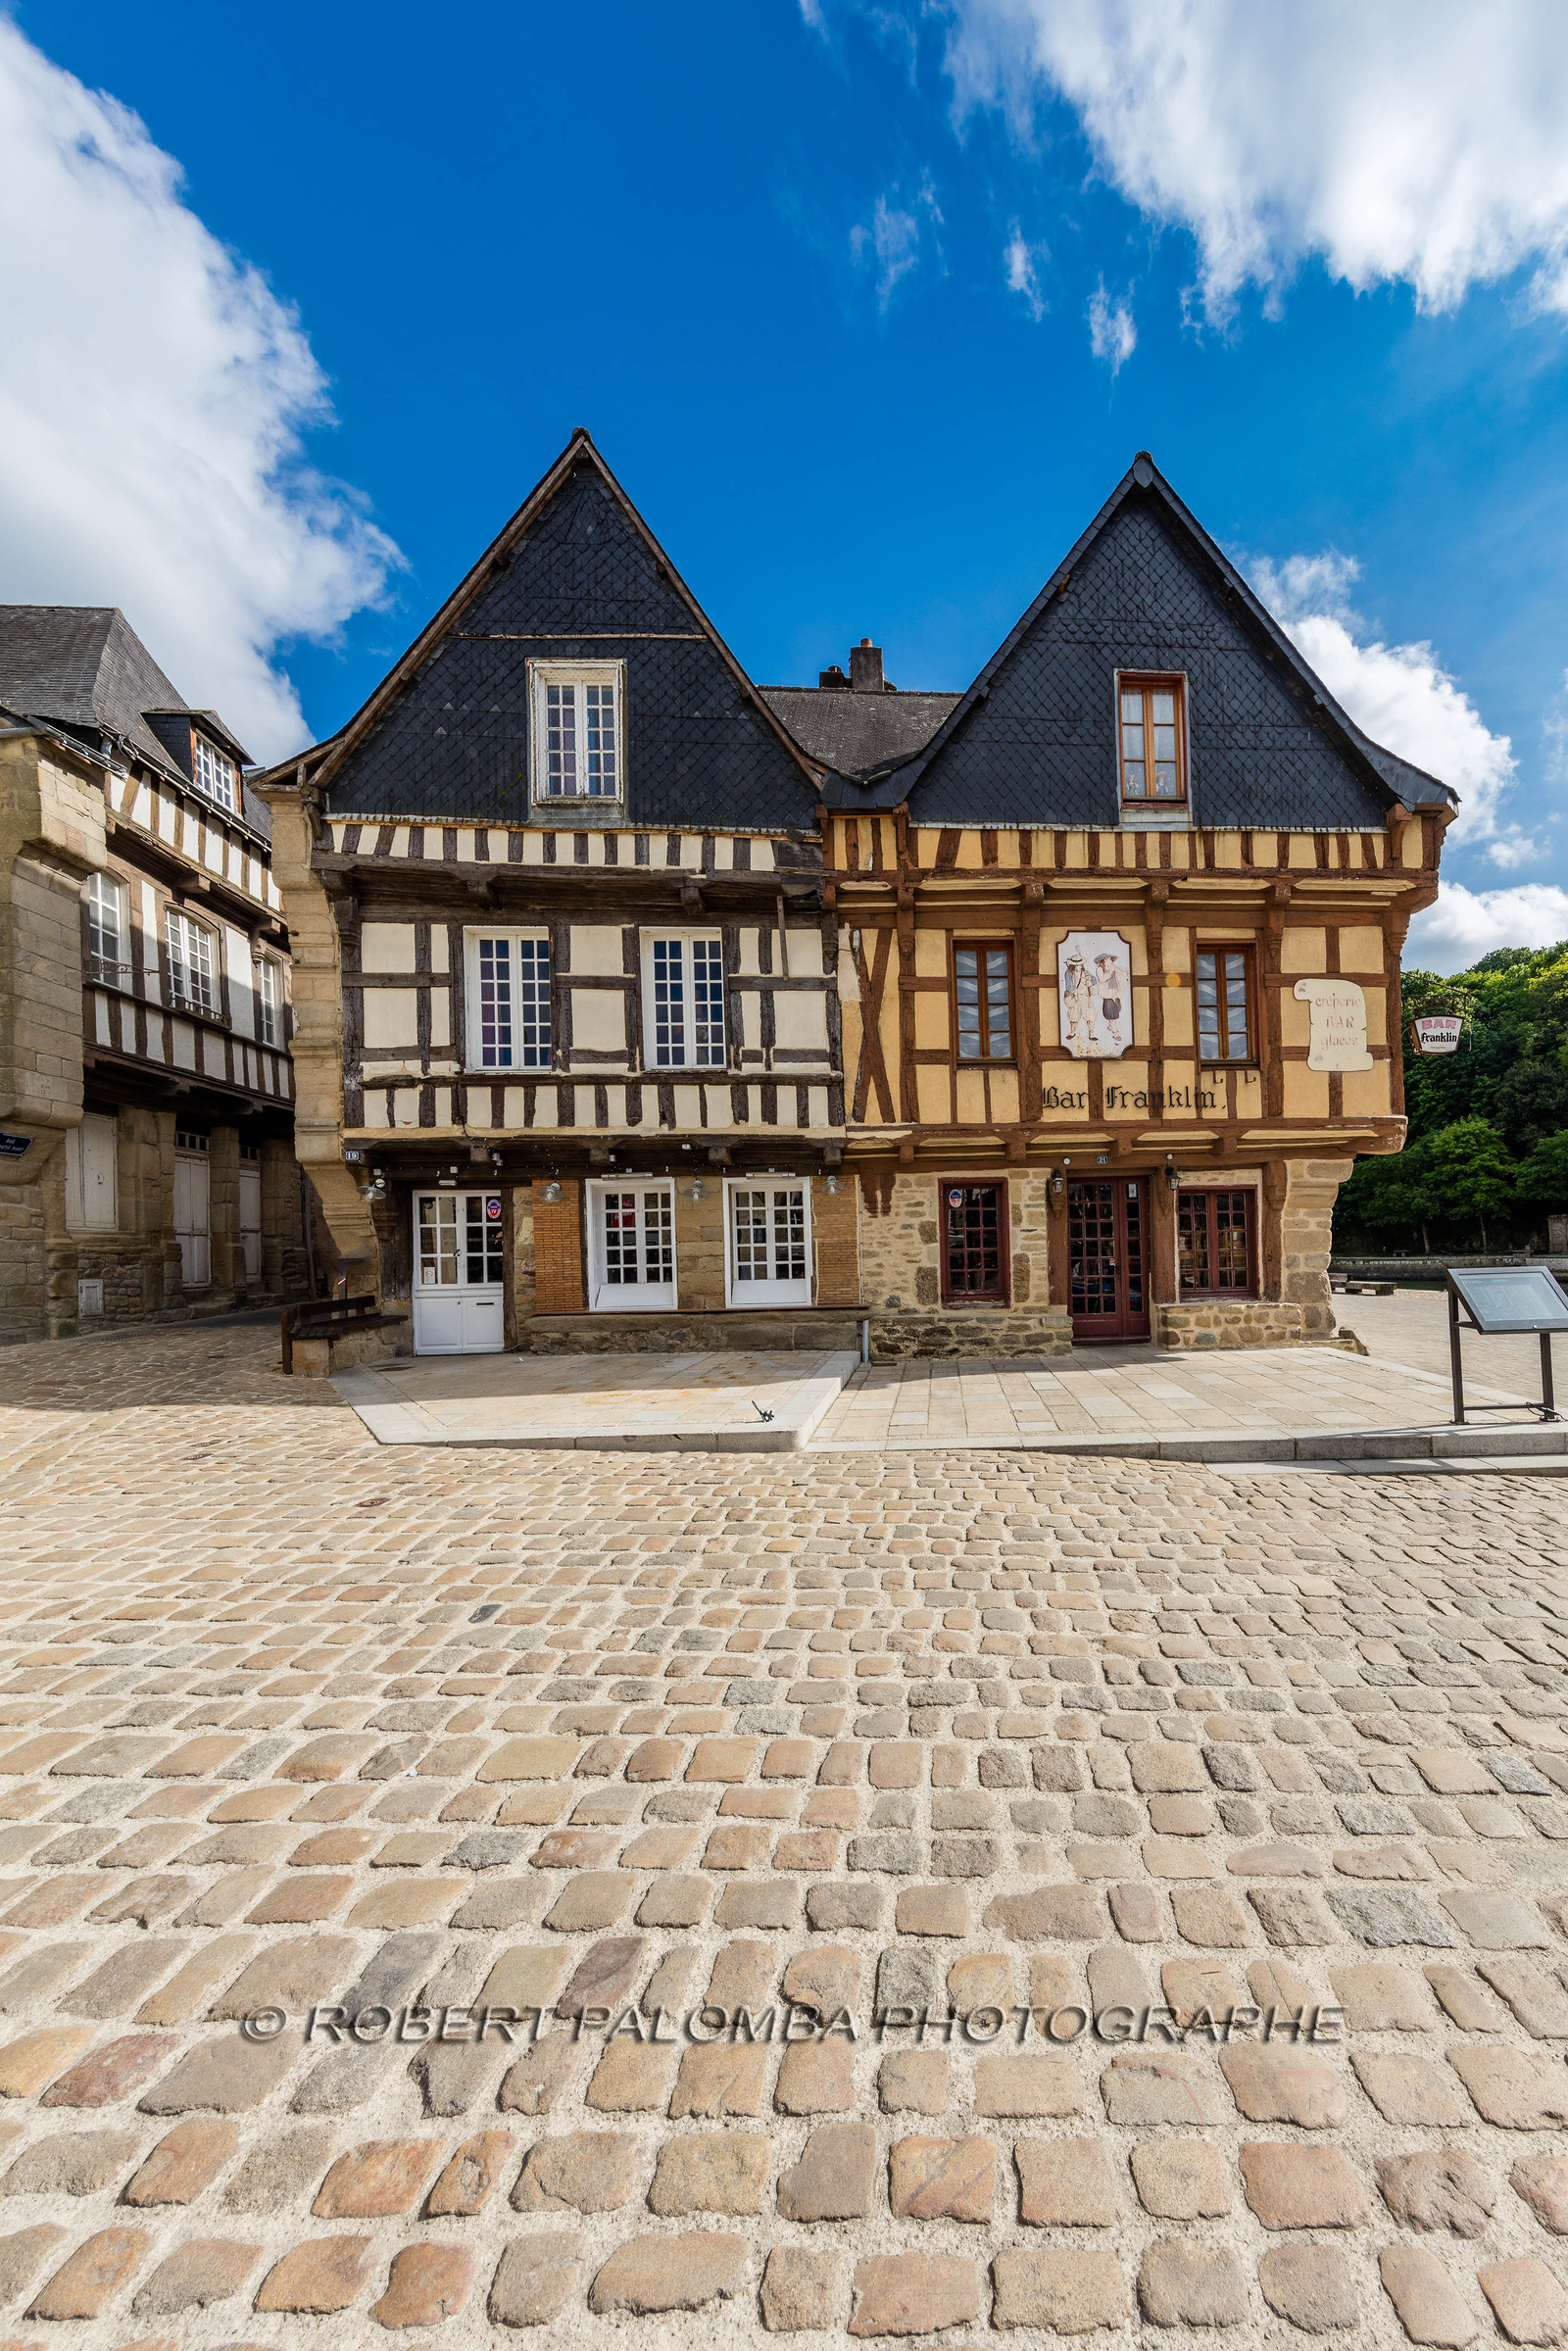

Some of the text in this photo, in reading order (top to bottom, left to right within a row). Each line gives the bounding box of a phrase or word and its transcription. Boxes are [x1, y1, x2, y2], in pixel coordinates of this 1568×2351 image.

[1326, 1015, 1354, 1028] BAR
[1421, 1019, 1457, 1029] BAR
[1320, 1034, 1359, 1052] glaces
[1043, 1086, 1090, 1109] Bar
